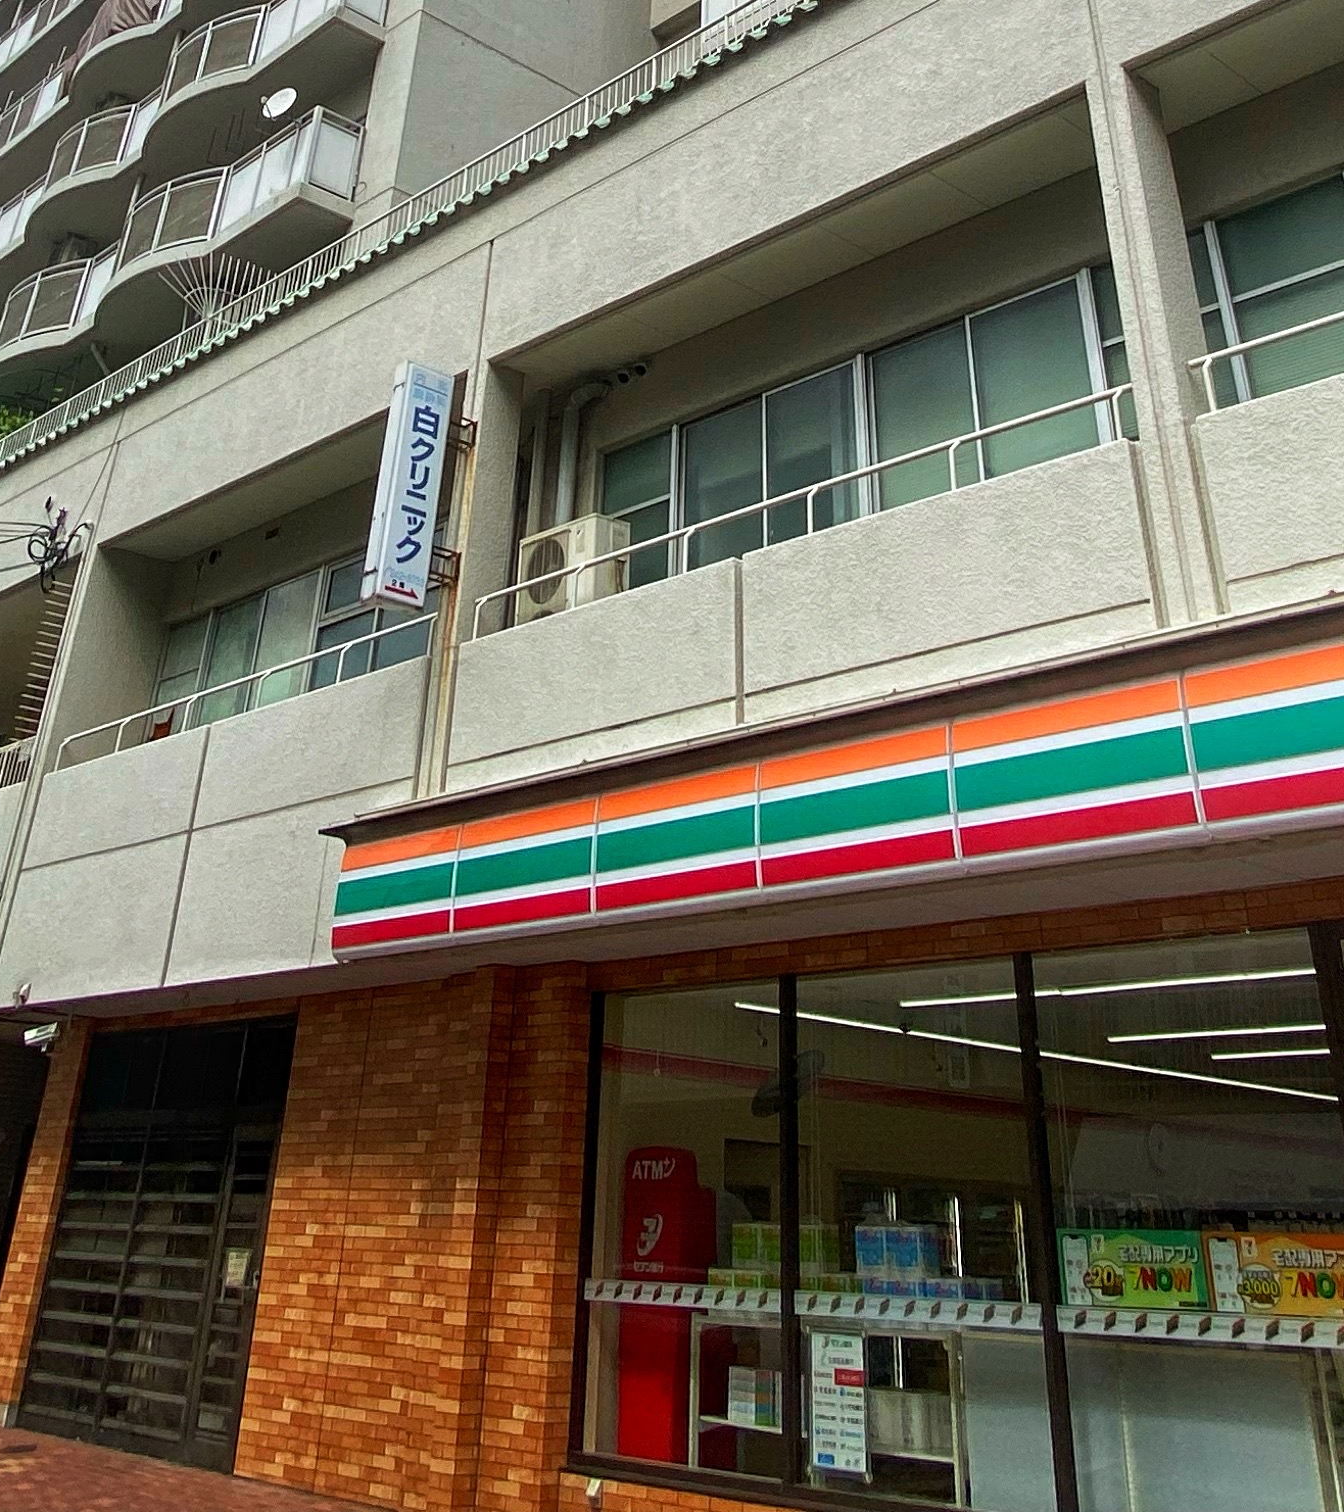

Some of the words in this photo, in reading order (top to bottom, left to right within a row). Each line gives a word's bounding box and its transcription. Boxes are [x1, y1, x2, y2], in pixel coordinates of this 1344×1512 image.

[396, 405, 440, 564] 白クリニック
[632, 1159, 663, 1180] ATM
